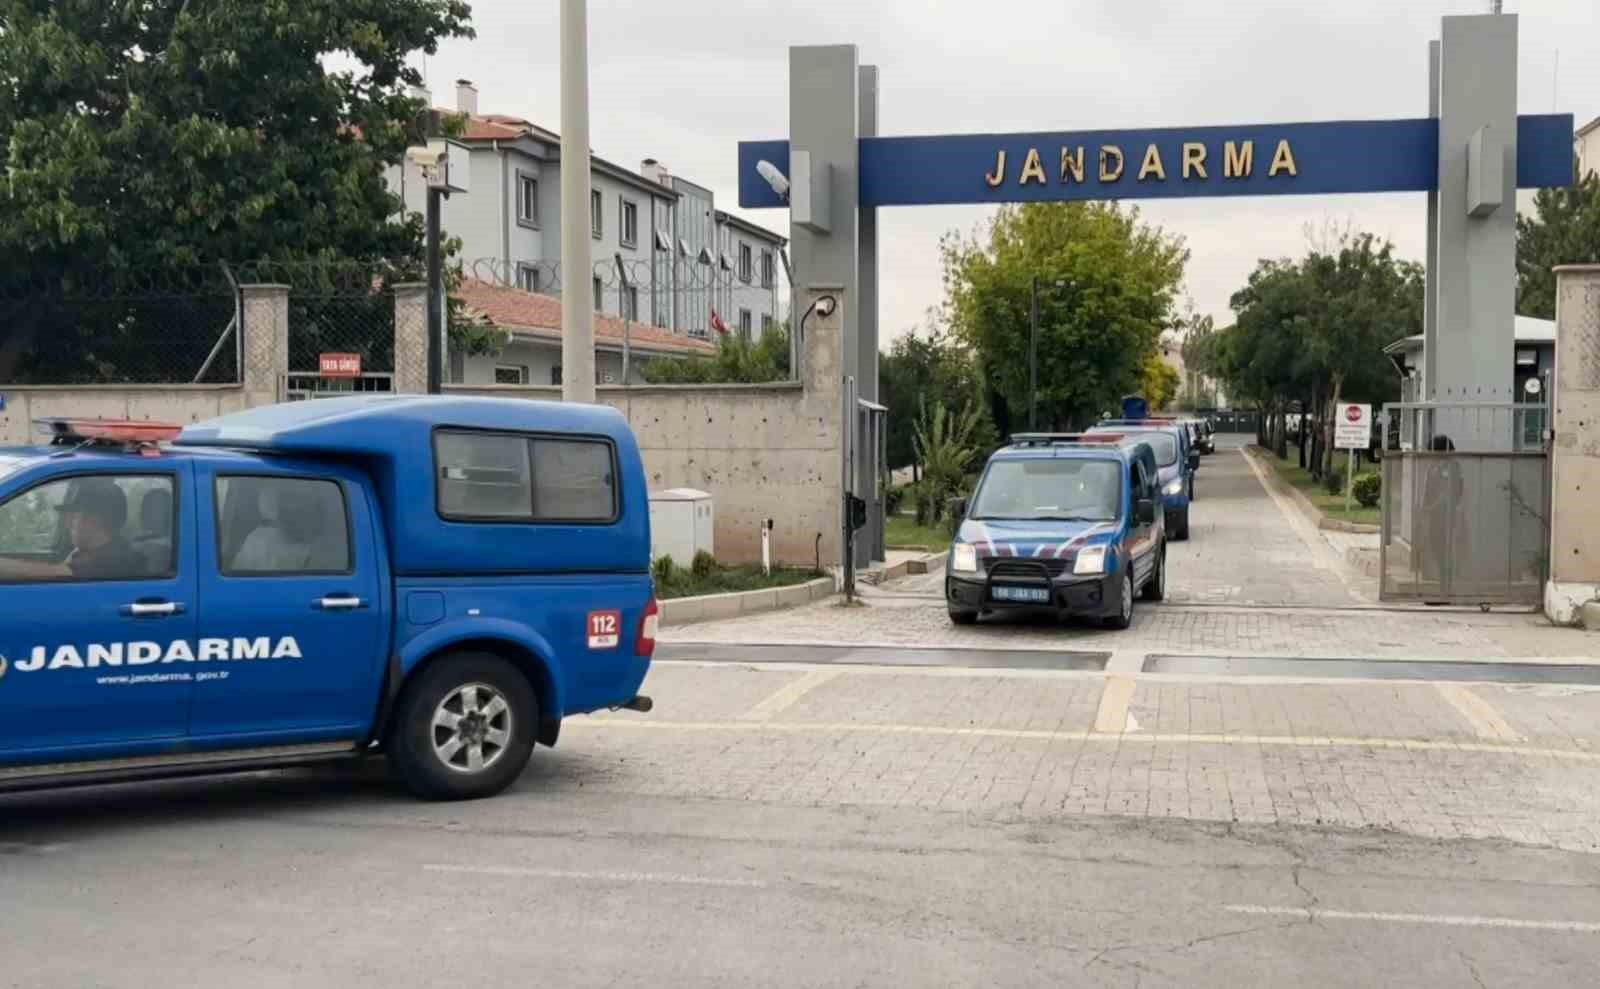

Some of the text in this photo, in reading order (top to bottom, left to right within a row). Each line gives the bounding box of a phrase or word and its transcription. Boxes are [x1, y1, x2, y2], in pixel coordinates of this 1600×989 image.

[984, 138, 1297, 187] JANDARMA
[592, 615, 615, 633] 112
[14, 636, 303, 671] JANDARMA
